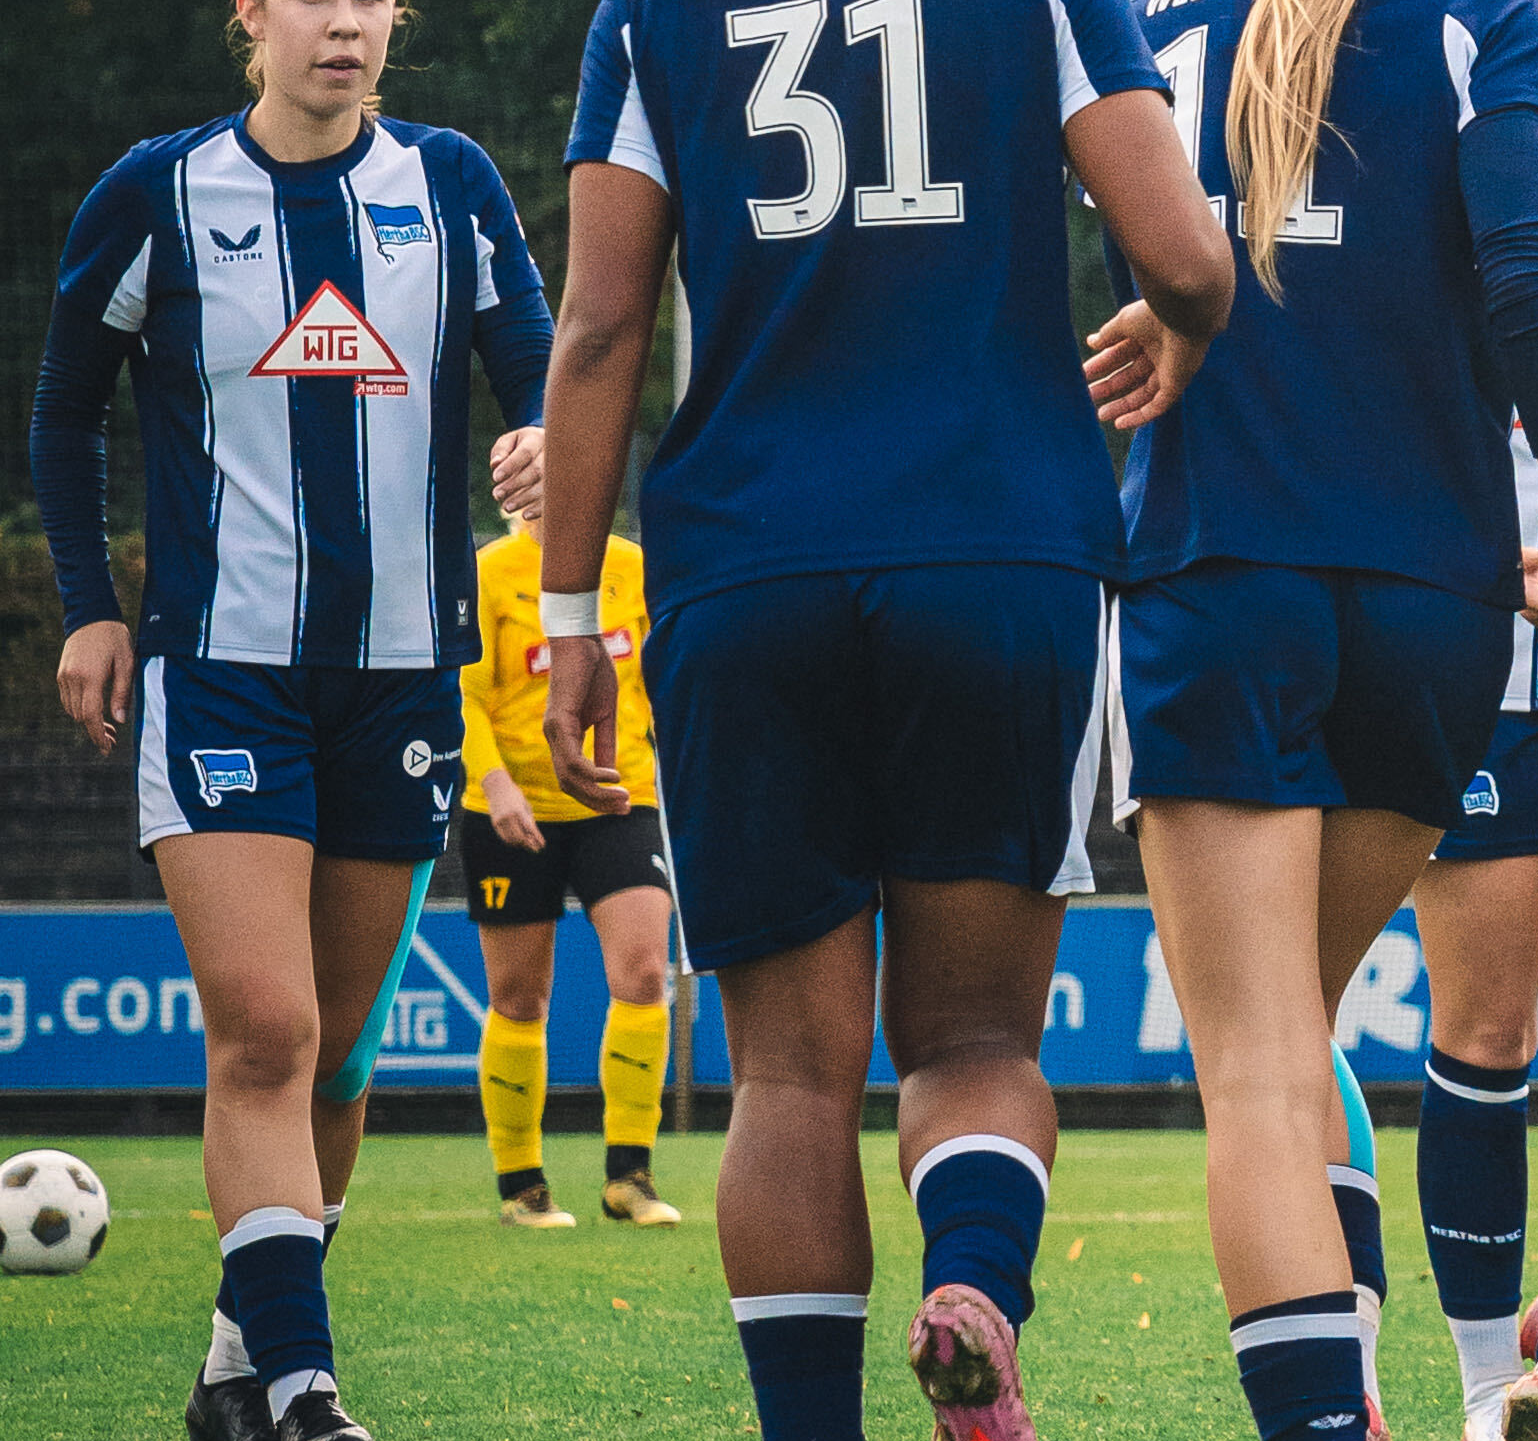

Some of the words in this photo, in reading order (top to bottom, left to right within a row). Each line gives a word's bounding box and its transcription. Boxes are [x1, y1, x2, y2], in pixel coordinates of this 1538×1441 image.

[303, 325, 358, 361] WTG
[480, 876, 511, 909] 17
[380, 989, 449, 1048] TG
